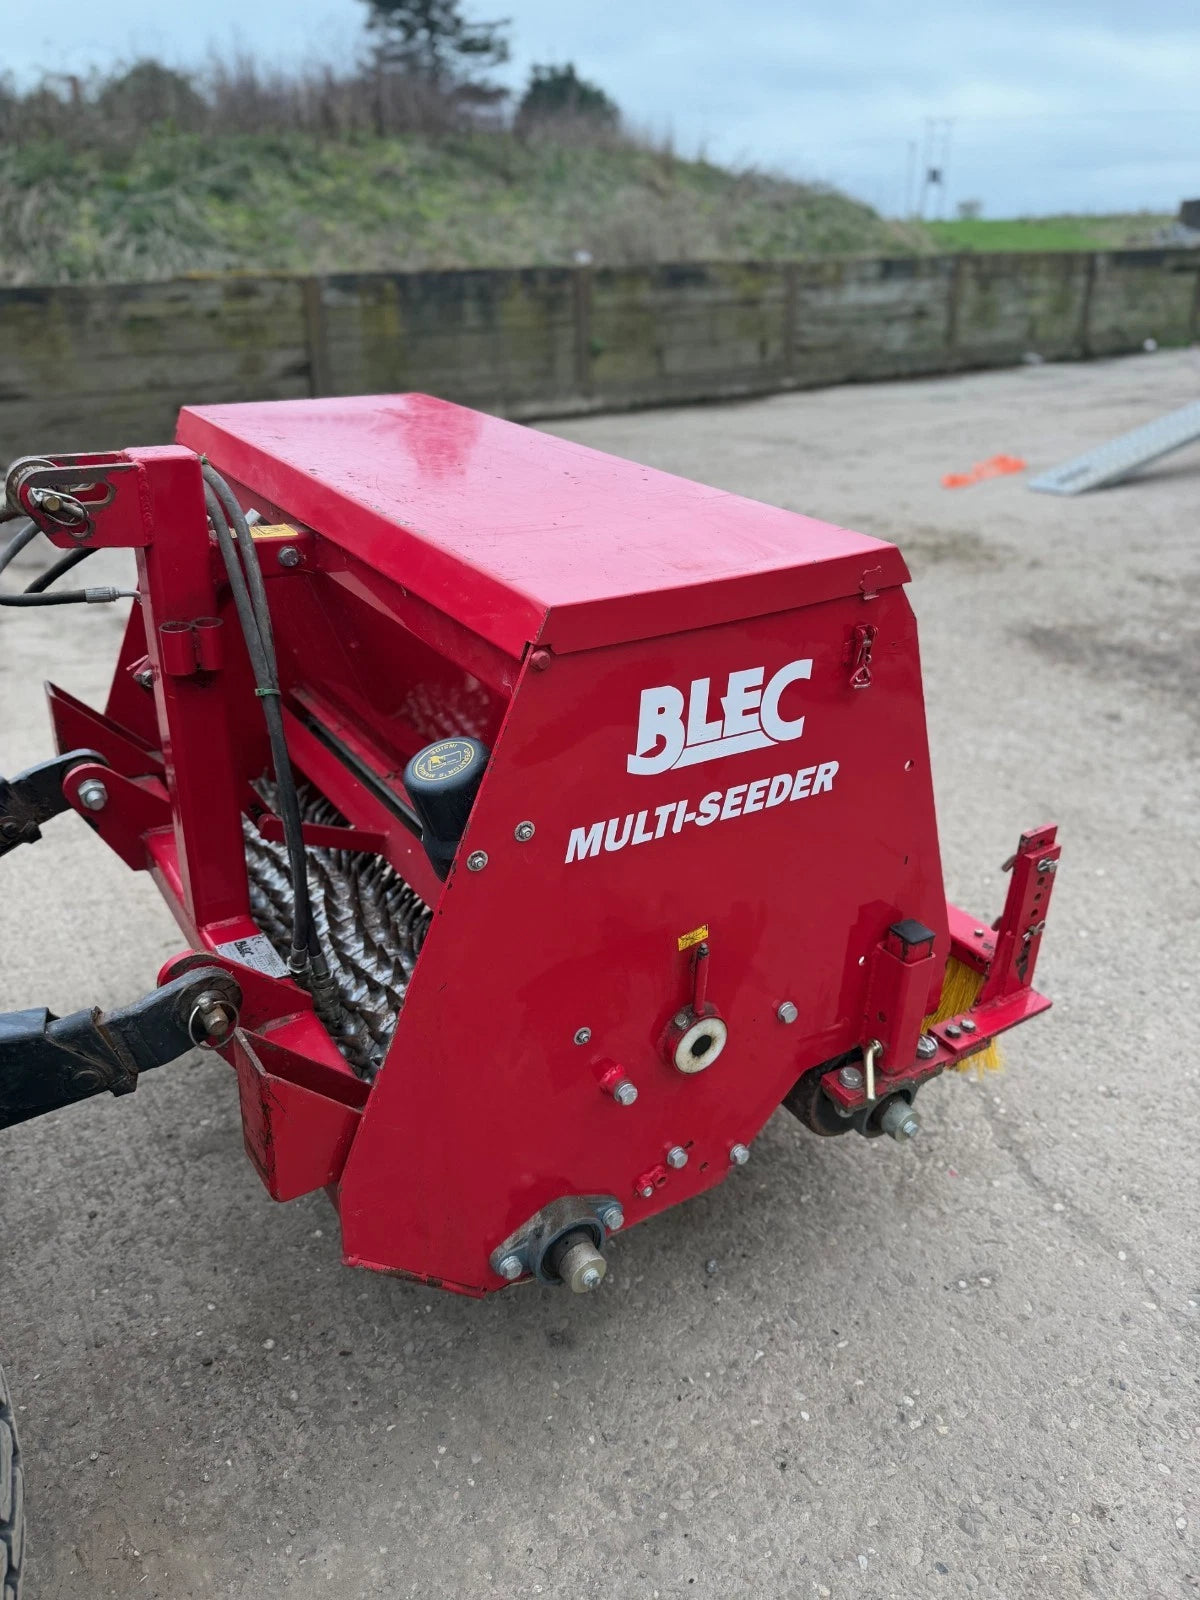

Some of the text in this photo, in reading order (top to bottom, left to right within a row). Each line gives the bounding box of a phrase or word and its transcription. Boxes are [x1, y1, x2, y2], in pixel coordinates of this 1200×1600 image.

[430, 744, 458, 755] INSIDE
[627, 659, 813, 775] BLEC
[565, 761, 839, 864] MULTI-SEEDER
